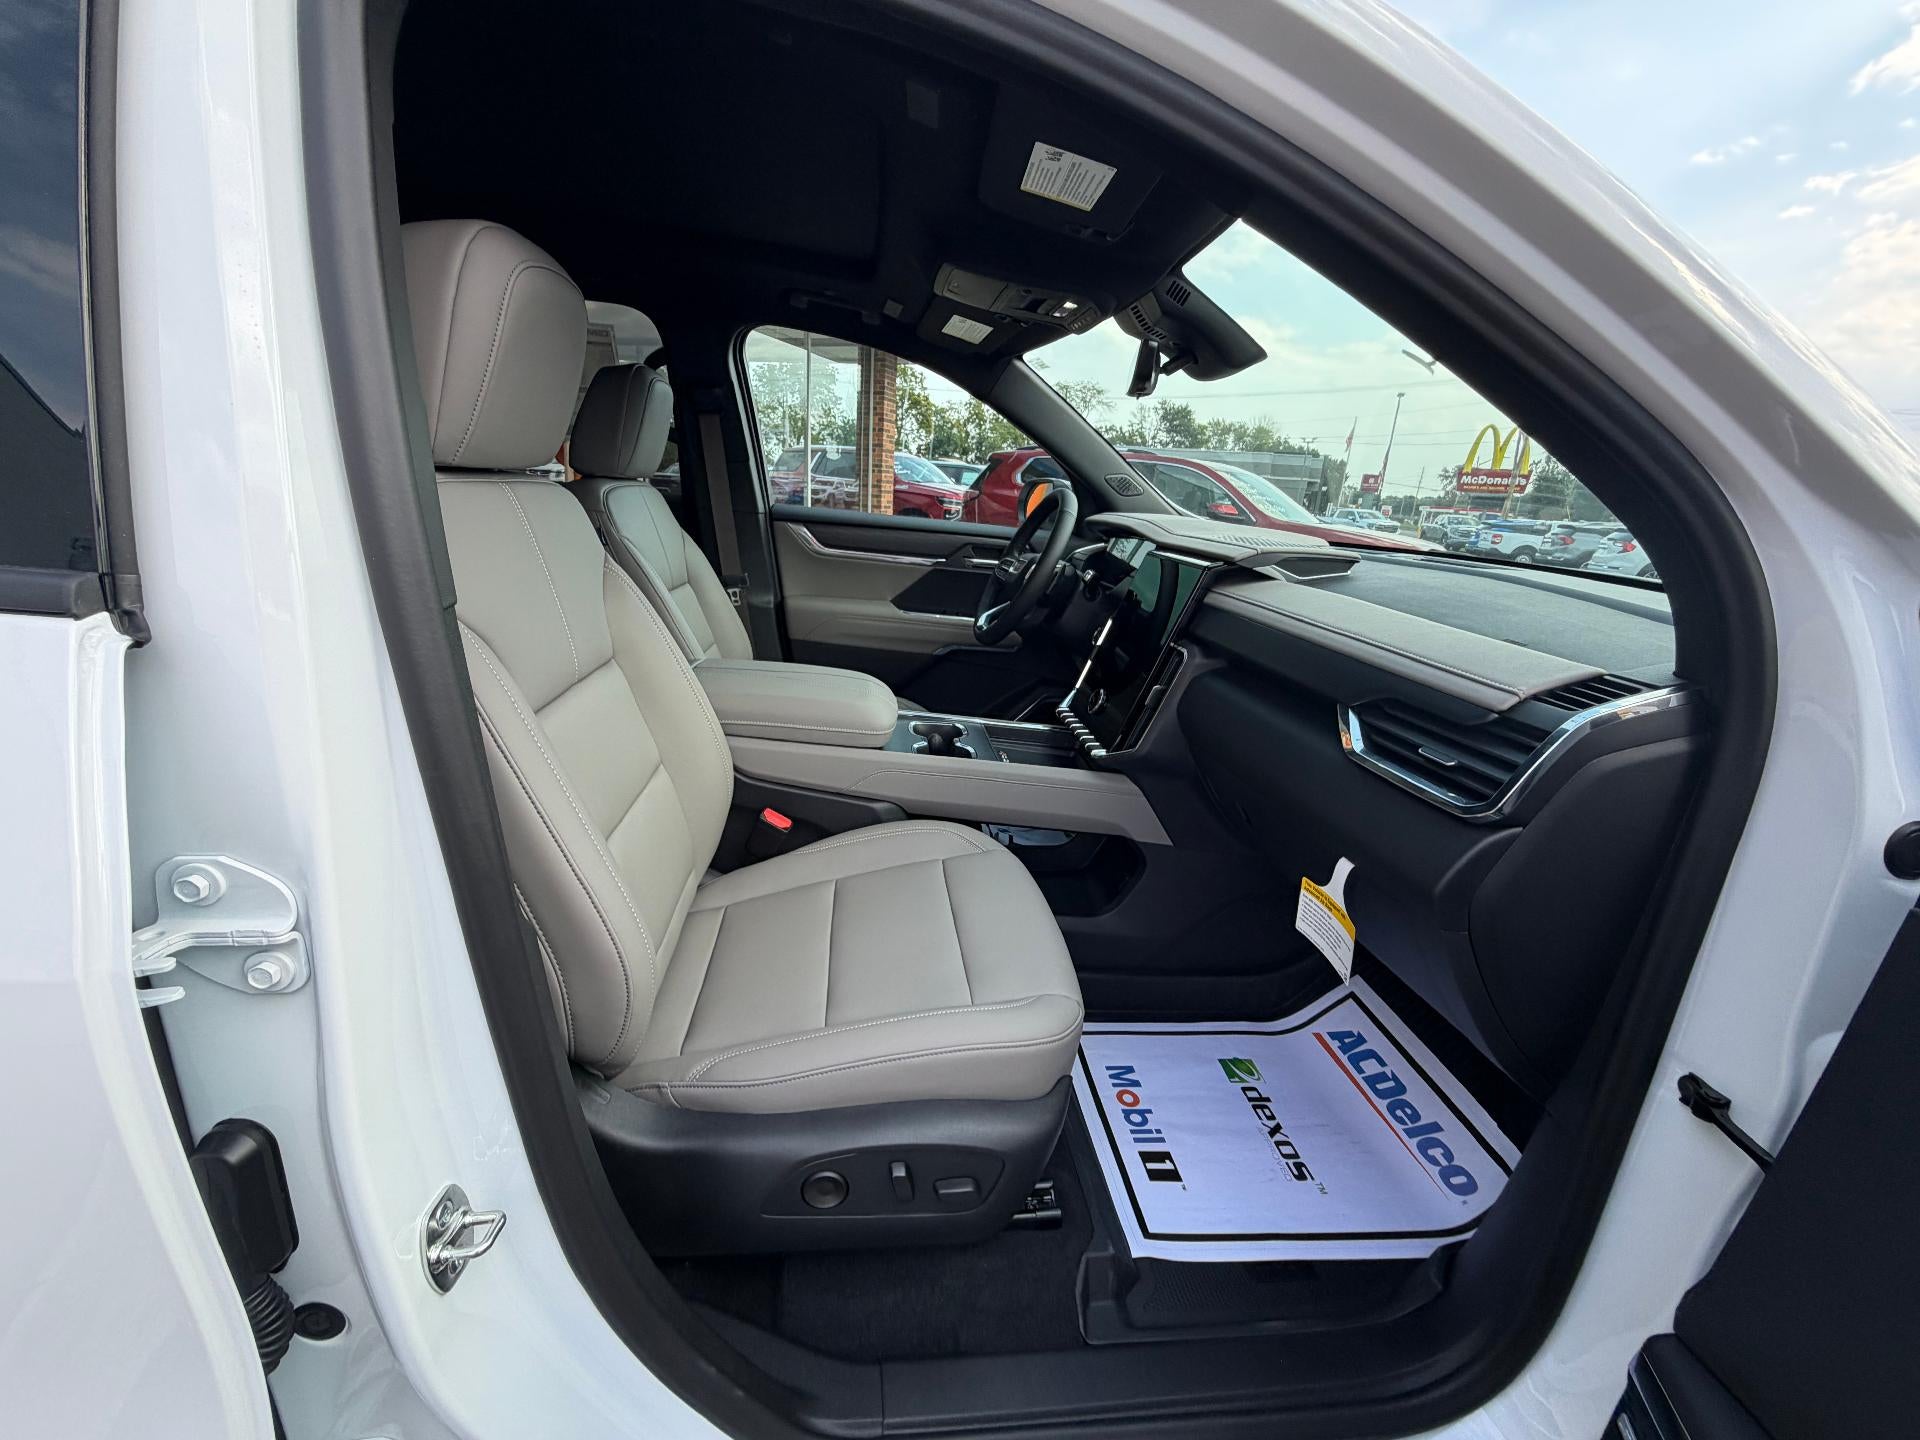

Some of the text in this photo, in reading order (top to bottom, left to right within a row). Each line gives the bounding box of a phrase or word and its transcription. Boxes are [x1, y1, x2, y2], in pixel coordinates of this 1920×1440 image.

[1104, 1065, 1167, 1144] Mobil
[1240, 1086, 1315, 1181] dexos
[1326, 1030, 1479, 1196] ACDelco
